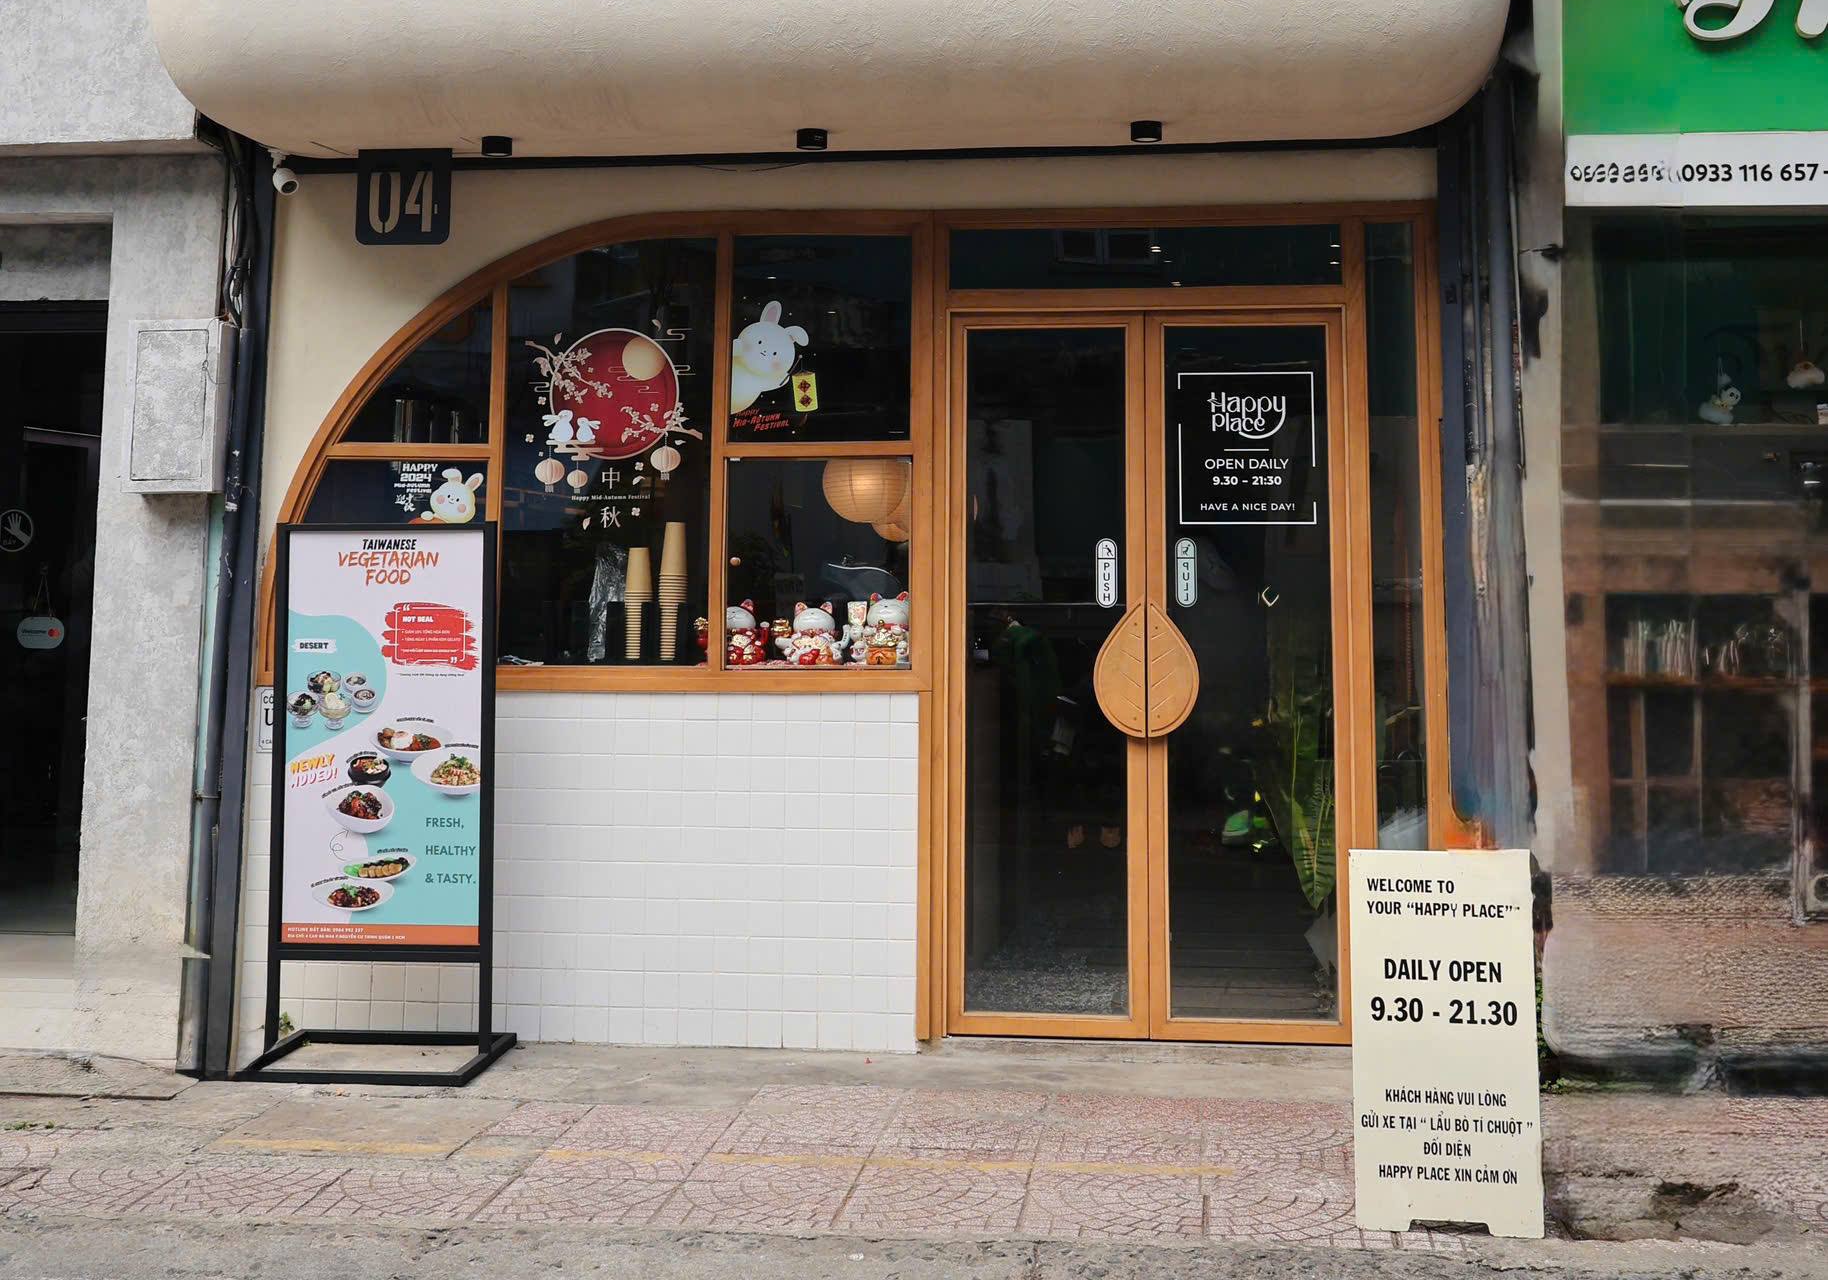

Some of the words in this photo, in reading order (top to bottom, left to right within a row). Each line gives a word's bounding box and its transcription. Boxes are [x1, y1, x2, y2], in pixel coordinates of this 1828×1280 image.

[1682, 164, 1733, 181] 0933
[1739, 164, 1772, 181] 116
[402, 463, 438, 472] HAPPY
[1204, 458, 1244, 469] OPEN
[1249, 458, 1289, 469] DAILY
[400, 473, 432, 482] 2024
[1212, 476, 1238, 485] 9.30
[1252, 476, 1282, 485] 21:30
[1200, 503, 1228, 511] HAVE
[1231, 503, 1239, 511] A
[1242, 503, 1267, 511] NICE
[1271, 503, 1295, 511] DAY!
[362, 539, 417, 550] TAIWANESE
[338, 551, 439, 568] VEGETARIAN
[365, 569, 411, 586] FOOD
[290, 753, 335, 774] NEWLY
[425, 817, 464, 829] FRESH,
[425, 845, 476, 856] HEALTHY
[425, 873, 435, 884] &
[437, 873, 476, 884] TASTY.
[1367, 878, 1432, 893] WELCOME
[1437, 880, 1455, 894] TO
[1367, 901, 1401, 915] YOUR
[1384, 958, 1441, 980] DAILY
[1449, 960, 1502, 983] OPEN
[1371, 996, 1423, 1022] 9.30
[1449, 999, 1517, 1026] 21.30
[1385, 1086, 1421, 1103] KHÁCH
[1425, 1087, 1454, 1105] HÀNG
[1457, 1092, 1474, 1106] VUI
[1478, 1089, 1507, 1107] LÒNG
[1361, 1109, 1378, 1128] GỬI
[1382, 1115, 1395, 1129] XE
[1399, 1116, 1416, 1132] TẠI
[1430, 1111, 1451, 1131] LẨU
[1455, 1116, 1469, 1132] BÒ
[1473, 1117, 1483, 1133] TÍ
[1487, 1118, 1523, 1137] CHUỘT
[1424, 1137, 1441, 1155] ĐỐI
[1446, 1140, 1471, 1159] DIỆN
[1379, 1165, 1413, 1179] HAPPY
[1417, 1166, 1450, 1181] PLACE
[1455, 1168, 1472, 1182] XIN
[1475, 1164, 1499, 1183] CẢM
[1503, 1170, 1518, 1184] ƠN
